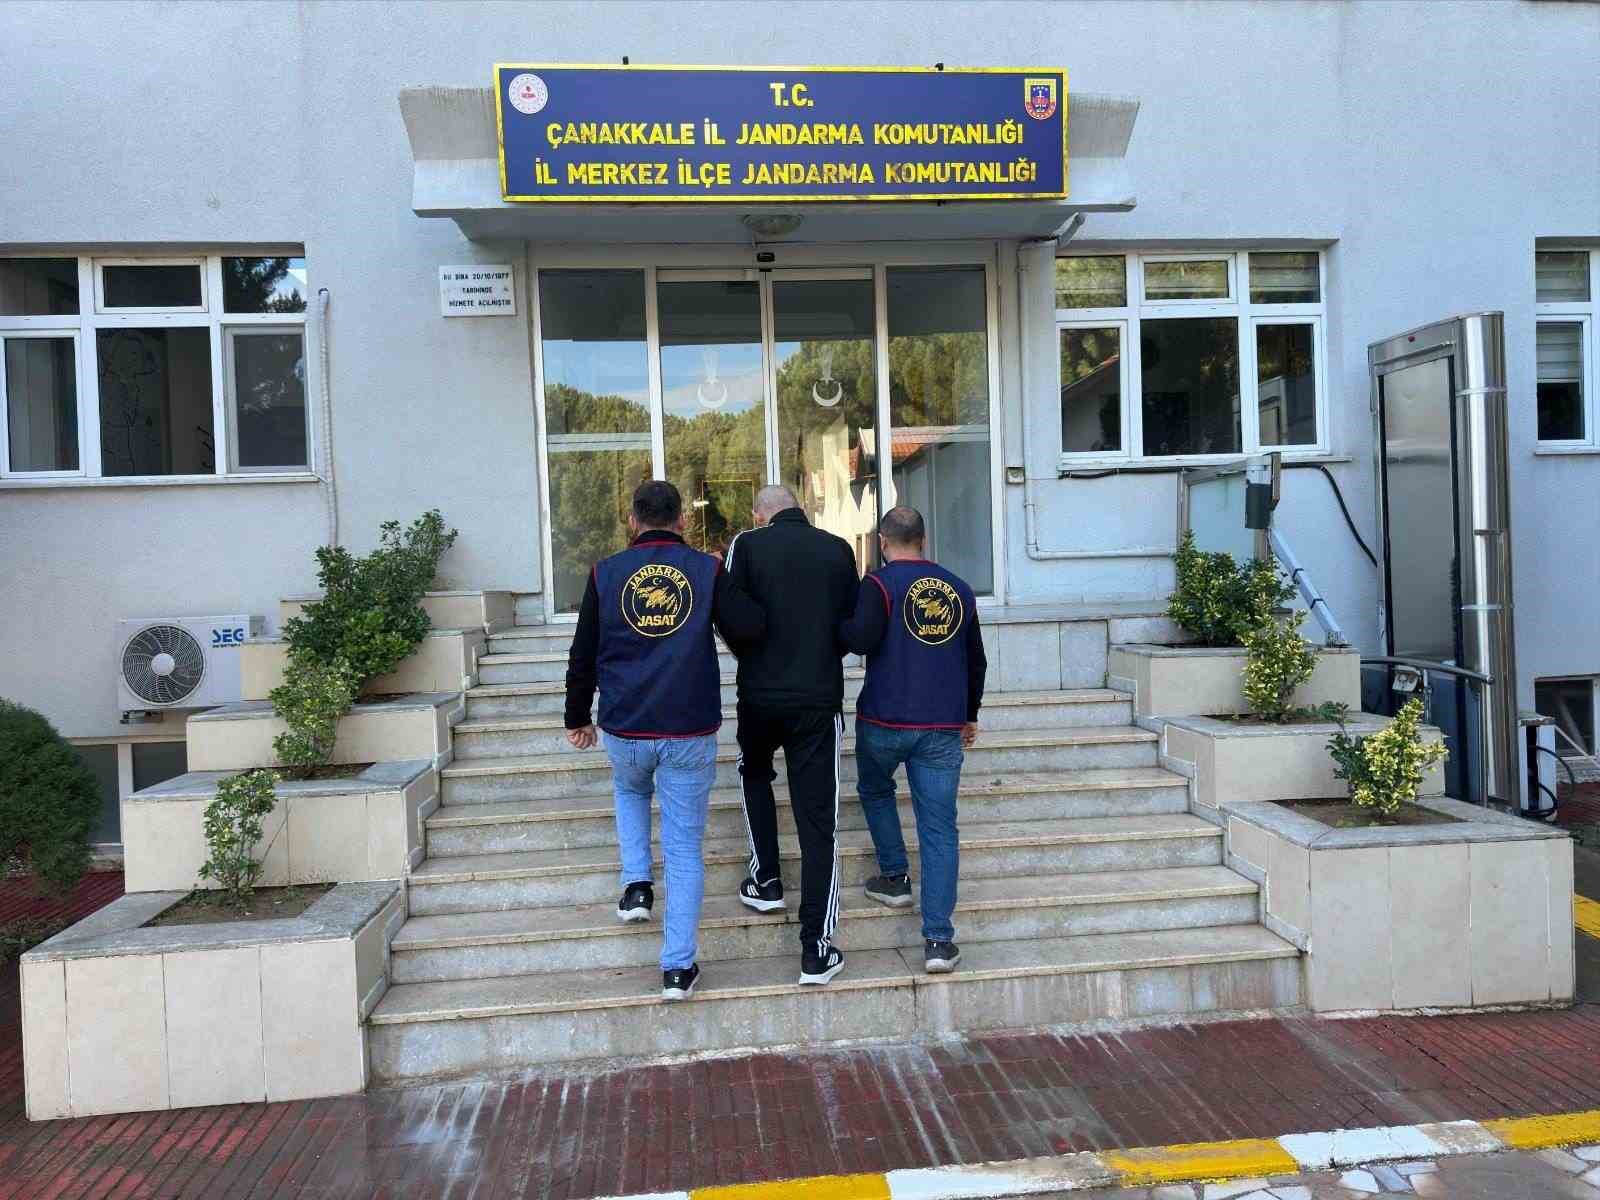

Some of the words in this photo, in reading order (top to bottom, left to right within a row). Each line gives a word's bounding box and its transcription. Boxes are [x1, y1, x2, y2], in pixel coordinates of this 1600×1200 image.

[770, 82, 815, 107] T.C.
[546, 122, 696, 150] ÇANAKKALE
[703, 117, 727, 145] İL
[735, 123, 865, 145] JANDARMA
[874, 118, 1025, 145] KOMUTANLIĞI
[535, 157, 558, 185] İL
[567, 162, 670, 185] MERKEZ
[677, 158, 732, 189] İLÇE
[741, 163, 875, 184] JANDARMA
[885, 156, 1038, 184] KOMUTANLIĞI
[629, 566, 687, 590] JANDARMA
[908, 579, 956, 601] JANDARMA
[637, 614, 677, 627] JASAT
[918, 623, 949, 636] JASAT
[212, 628, 244, 643] SEG
